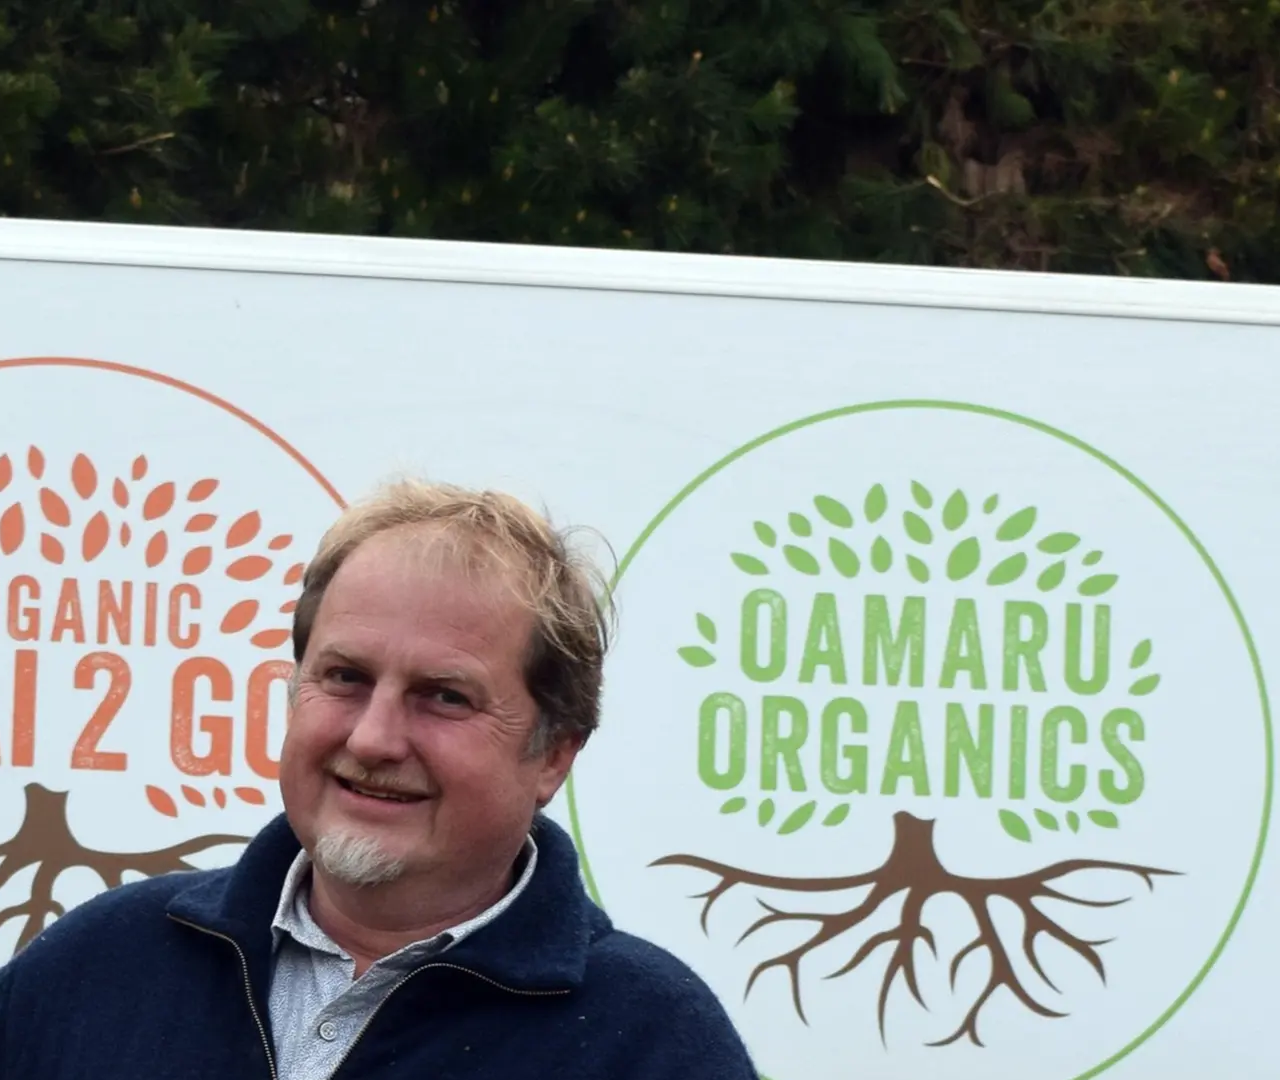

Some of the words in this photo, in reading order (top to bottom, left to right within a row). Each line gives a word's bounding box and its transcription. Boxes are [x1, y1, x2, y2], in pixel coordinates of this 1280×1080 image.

[738, 587, 1111, 696] OAMARU
[69, 650, 133, 772] 2
[168, 655, 296, 781] GO
[696, 690, 1147, 805] ORGANICS
